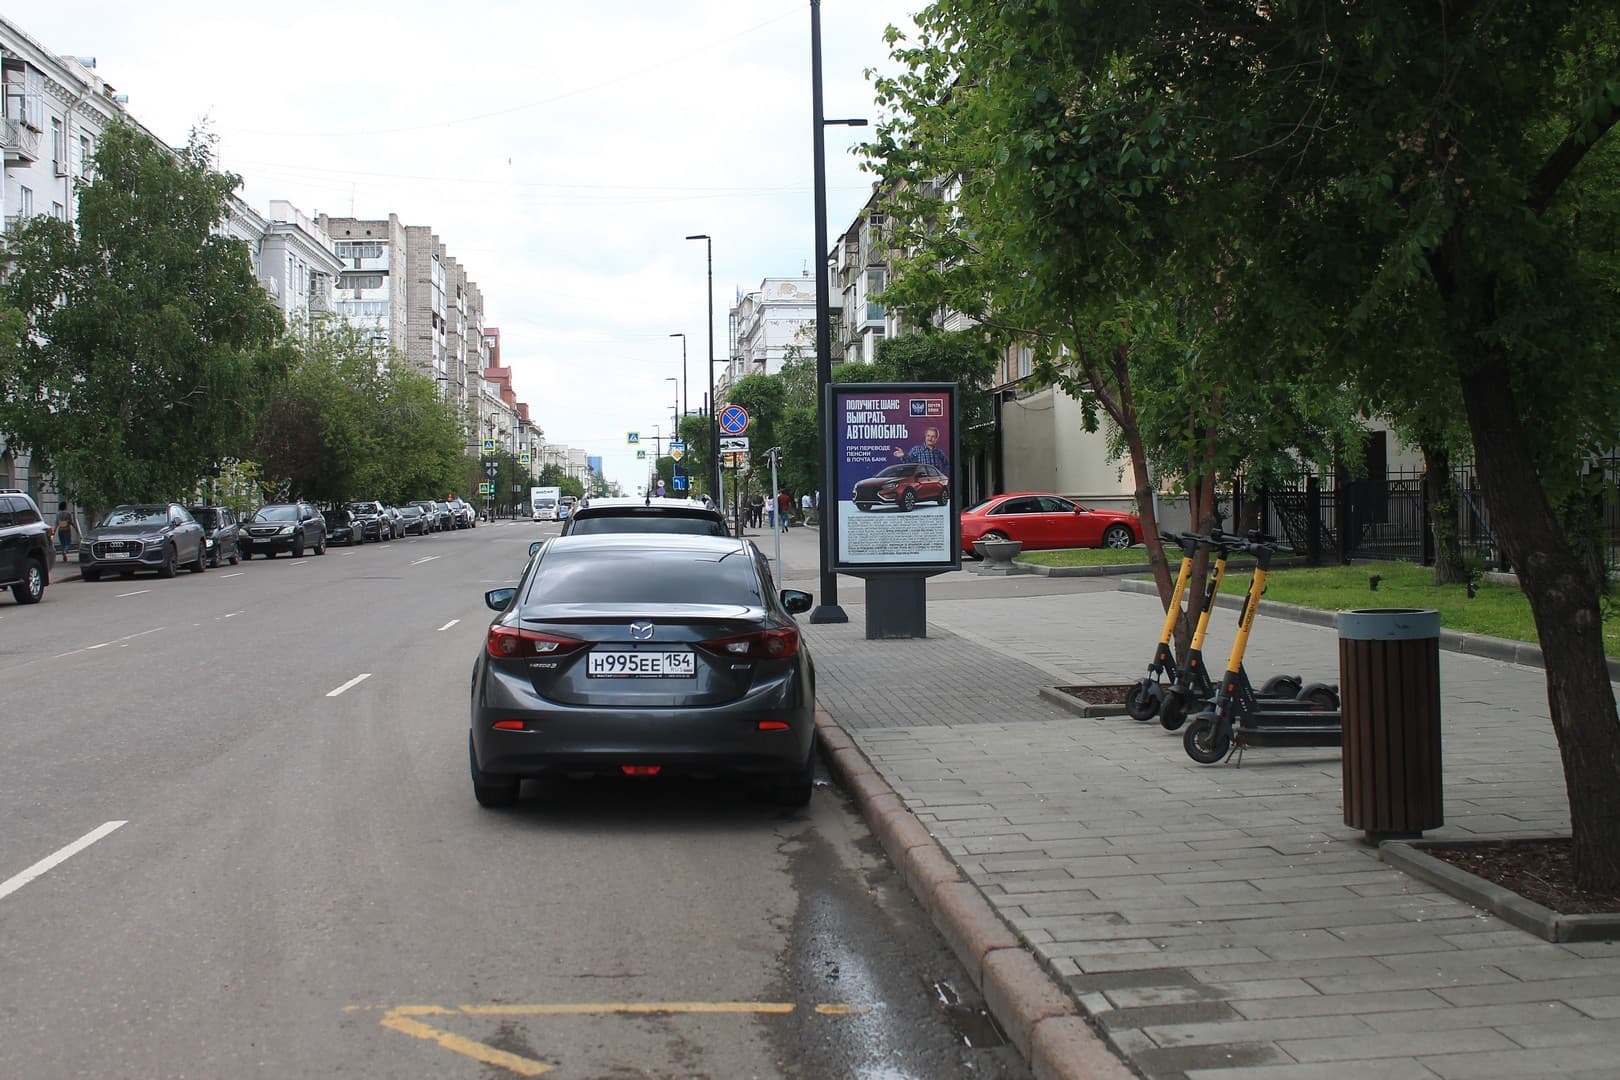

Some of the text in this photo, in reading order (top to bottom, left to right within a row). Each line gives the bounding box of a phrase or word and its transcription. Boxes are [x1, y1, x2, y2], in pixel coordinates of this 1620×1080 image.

[846, 399, 900, 410] ПОЛУЧИТЕ ШАНС
[846, 411, 886, 424] ВЫИГРАТЬ
[846, 424, 909, 439] АВТОМОБИЛЬ
[665, 653, 690, 668] 154
